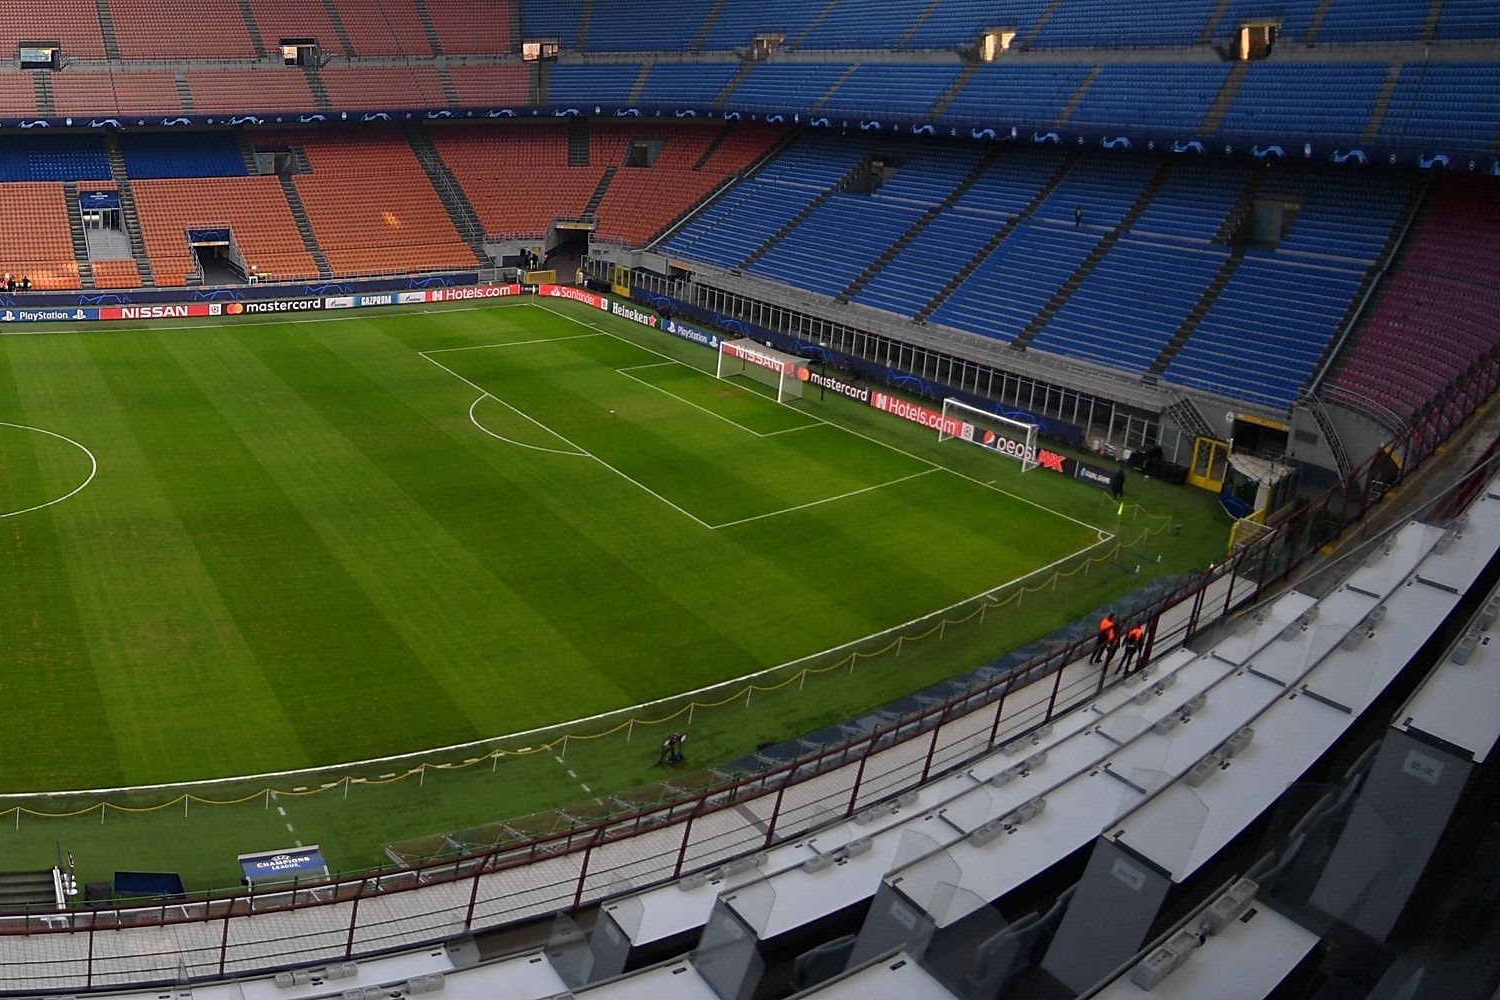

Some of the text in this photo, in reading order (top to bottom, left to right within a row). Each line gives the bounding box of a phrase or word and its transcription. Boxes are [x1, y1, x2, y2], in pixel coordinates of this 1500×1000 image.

[446, 285, 510, 300] Hotels.com
[561, 287, 595, 305] Santander
[121, 306, 188, 318] NISSAN
[246, 298, 321, 313] mastercard
[612, 303, 649, 325] Heineken
[20, 310, 68, 320] PlayStation
[677, 324, 708, 343] PlayStation
[811, 372, 868, 402] mastercard
[889, 397, 956, 435] Hotels.com
[996, 437, 1036, 462] pepsi
[256, 856, 310, 868] CHAMPIONS
